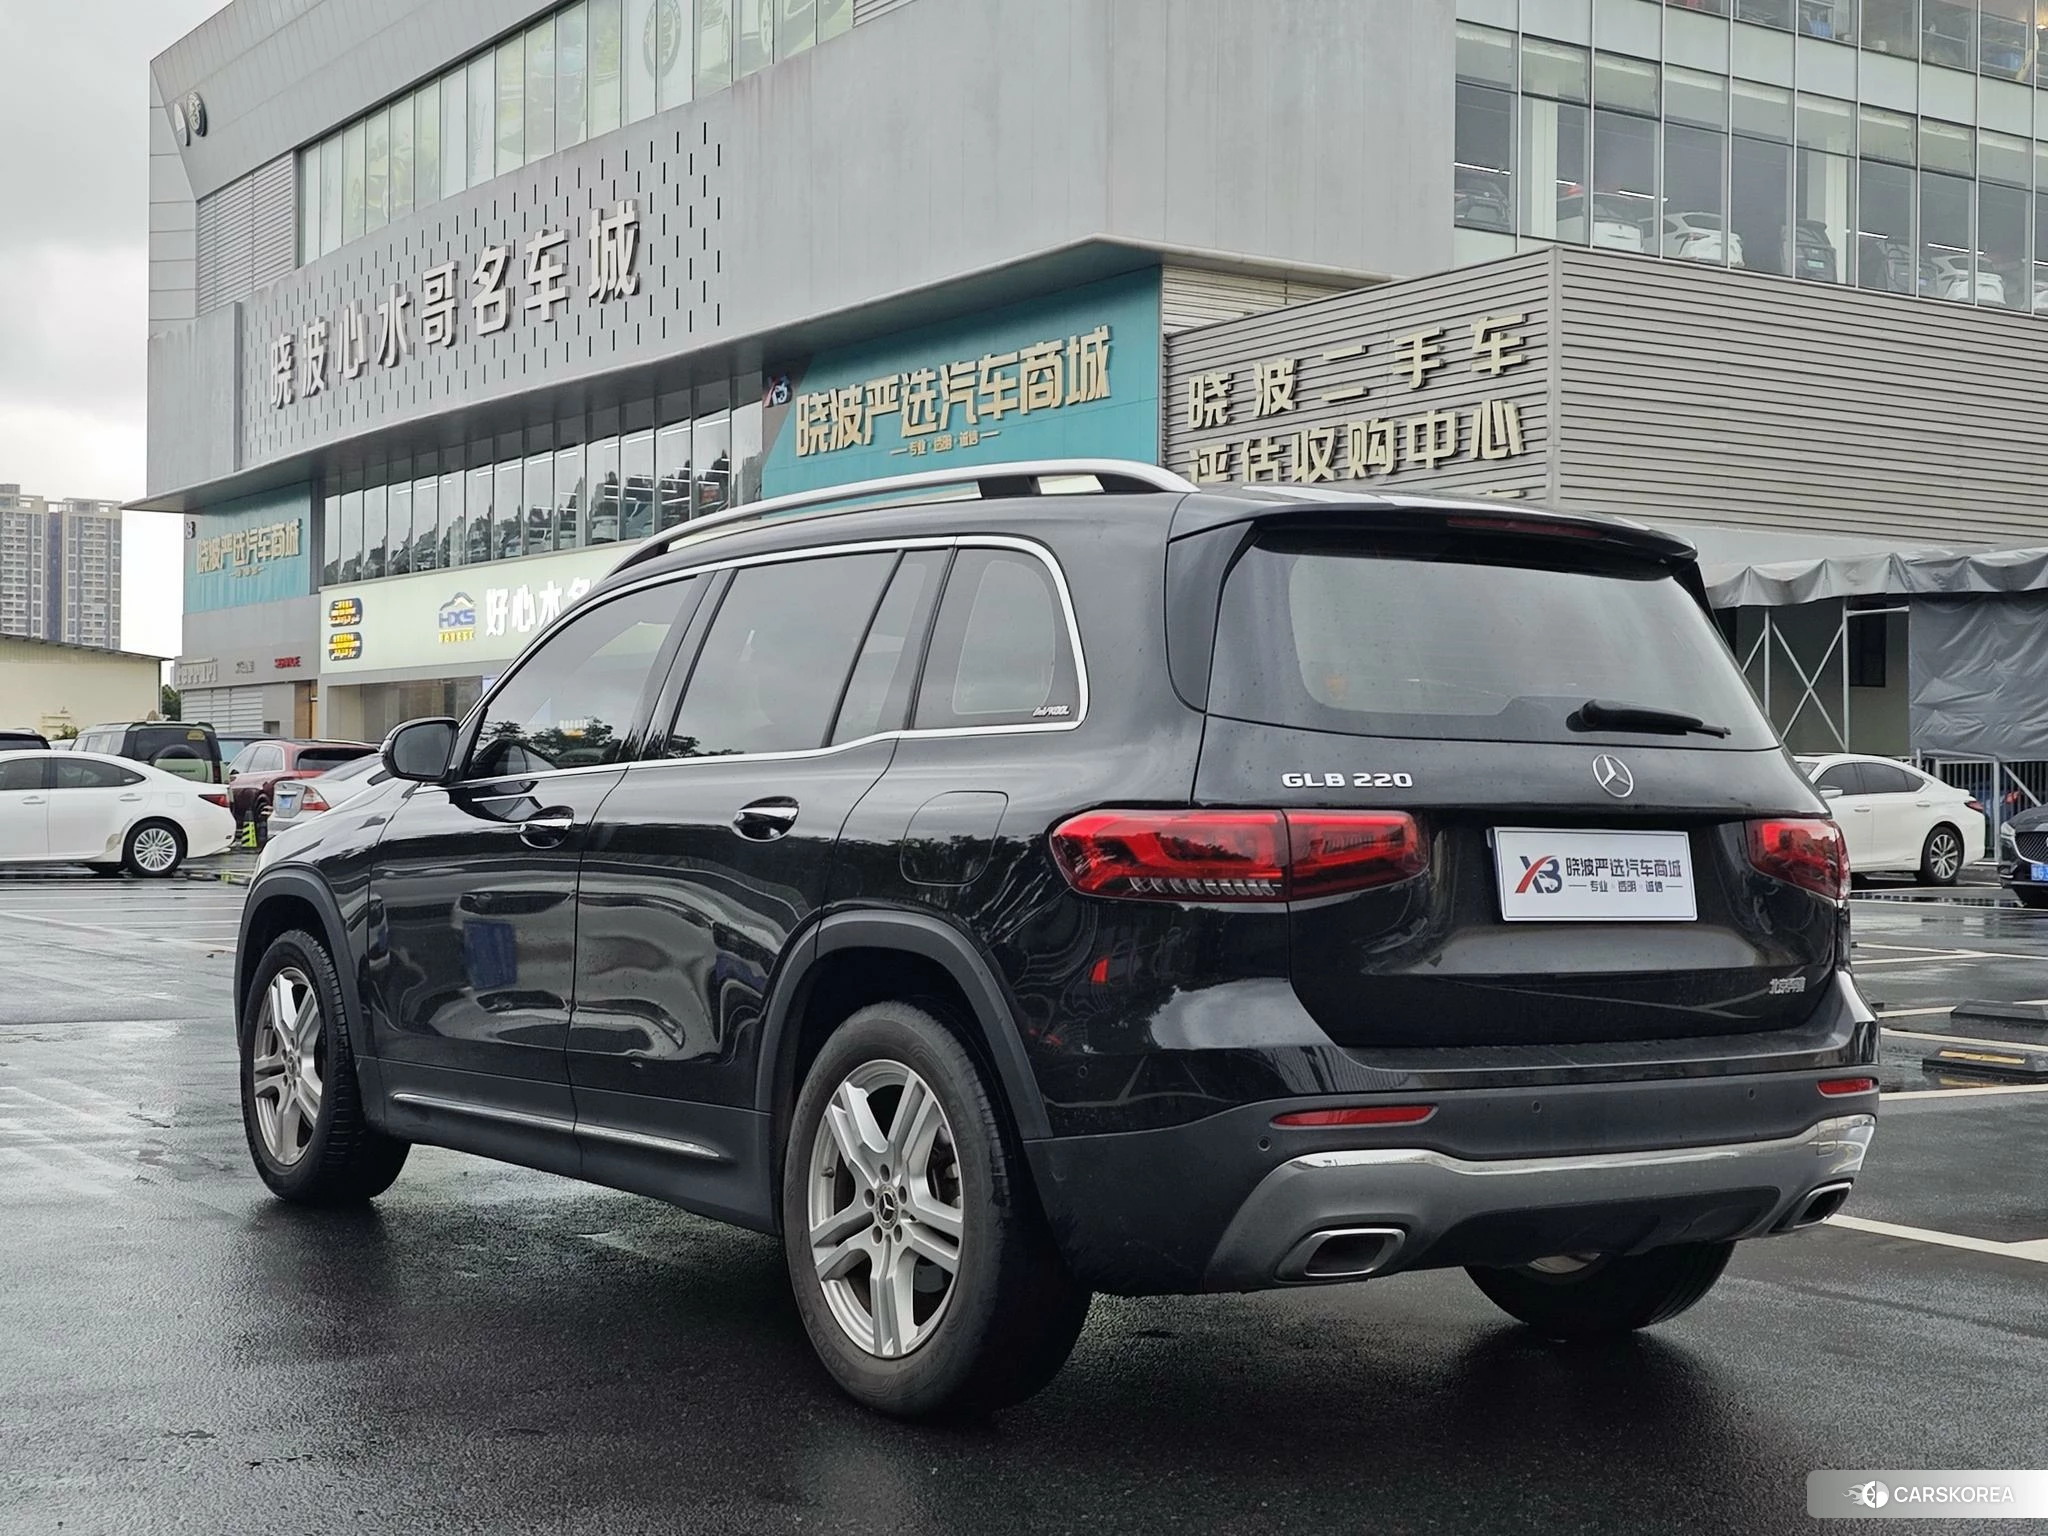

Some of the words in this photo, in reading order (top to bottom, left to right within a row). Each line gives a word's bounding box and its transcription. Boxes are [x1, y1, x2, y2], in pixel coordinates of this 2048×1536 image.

[269, 199, 640, 410] 晓波心水哥名车城
[796, 324, 1112, 457] 晓波严选汽车商城
[1188, 313, 1527, 429] 晓波二手车
[1188, 400, 1526, 483] 评估收购中心
[1281, 772, 1346, 788] GLB
[1352, 772, 1413, 788] 220
[1566, 857, 1682, 878] 晓波严选汽车商城
